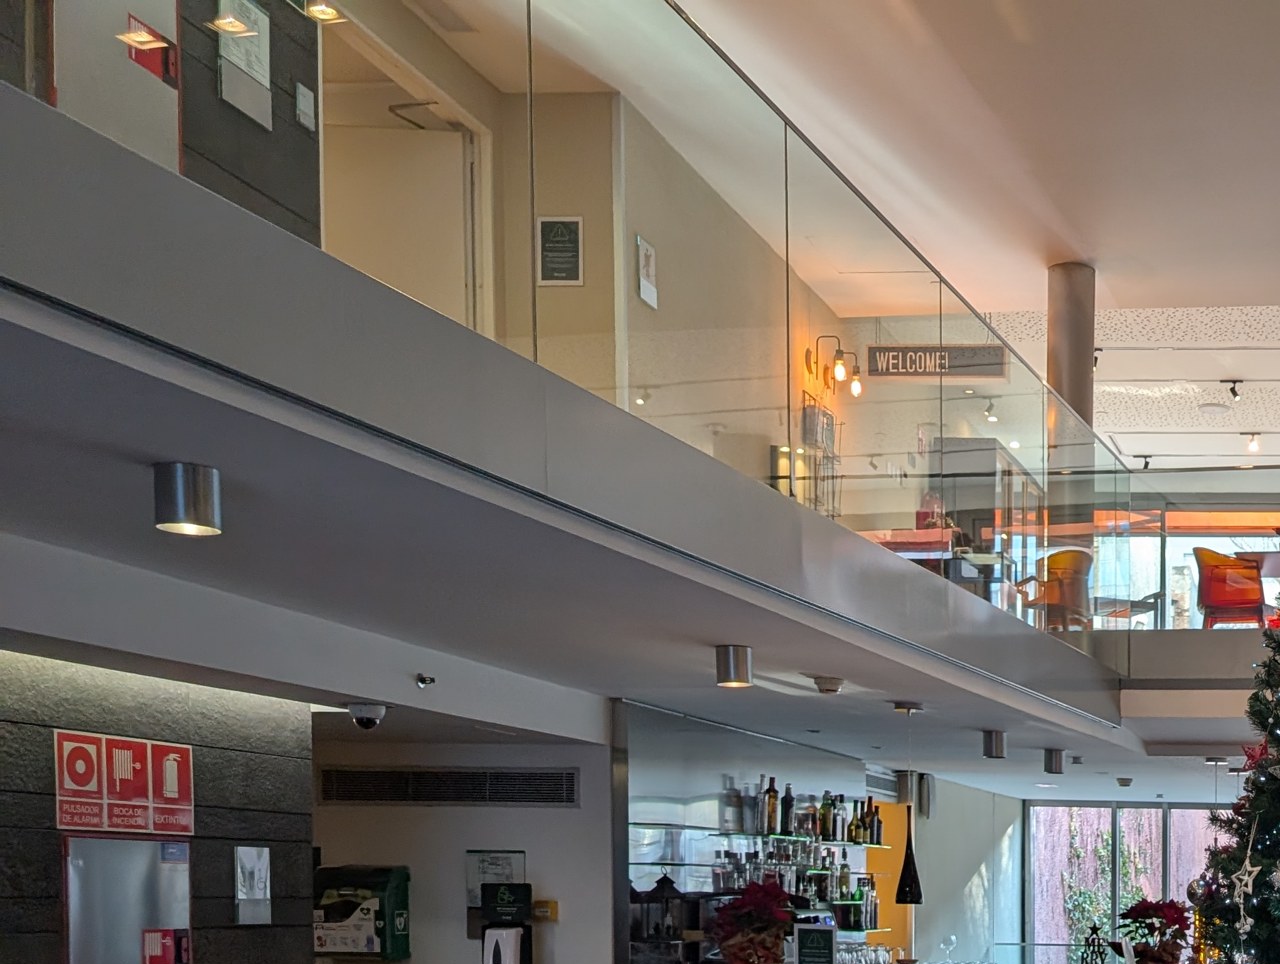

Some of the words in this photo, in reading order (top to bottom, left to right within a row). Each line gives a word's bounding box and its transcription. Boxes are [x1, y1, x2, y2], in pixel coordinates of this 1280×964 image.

[876, 351, 949, 373] WELCOME!
[63, 803, 99, 814] PULSADOR
[113, 807, 133, 816] BOCA
[134, 808, 145, 817] DE
[63, 814, 72, 822] DE
[73, 815, 100, 824] ALARMA
